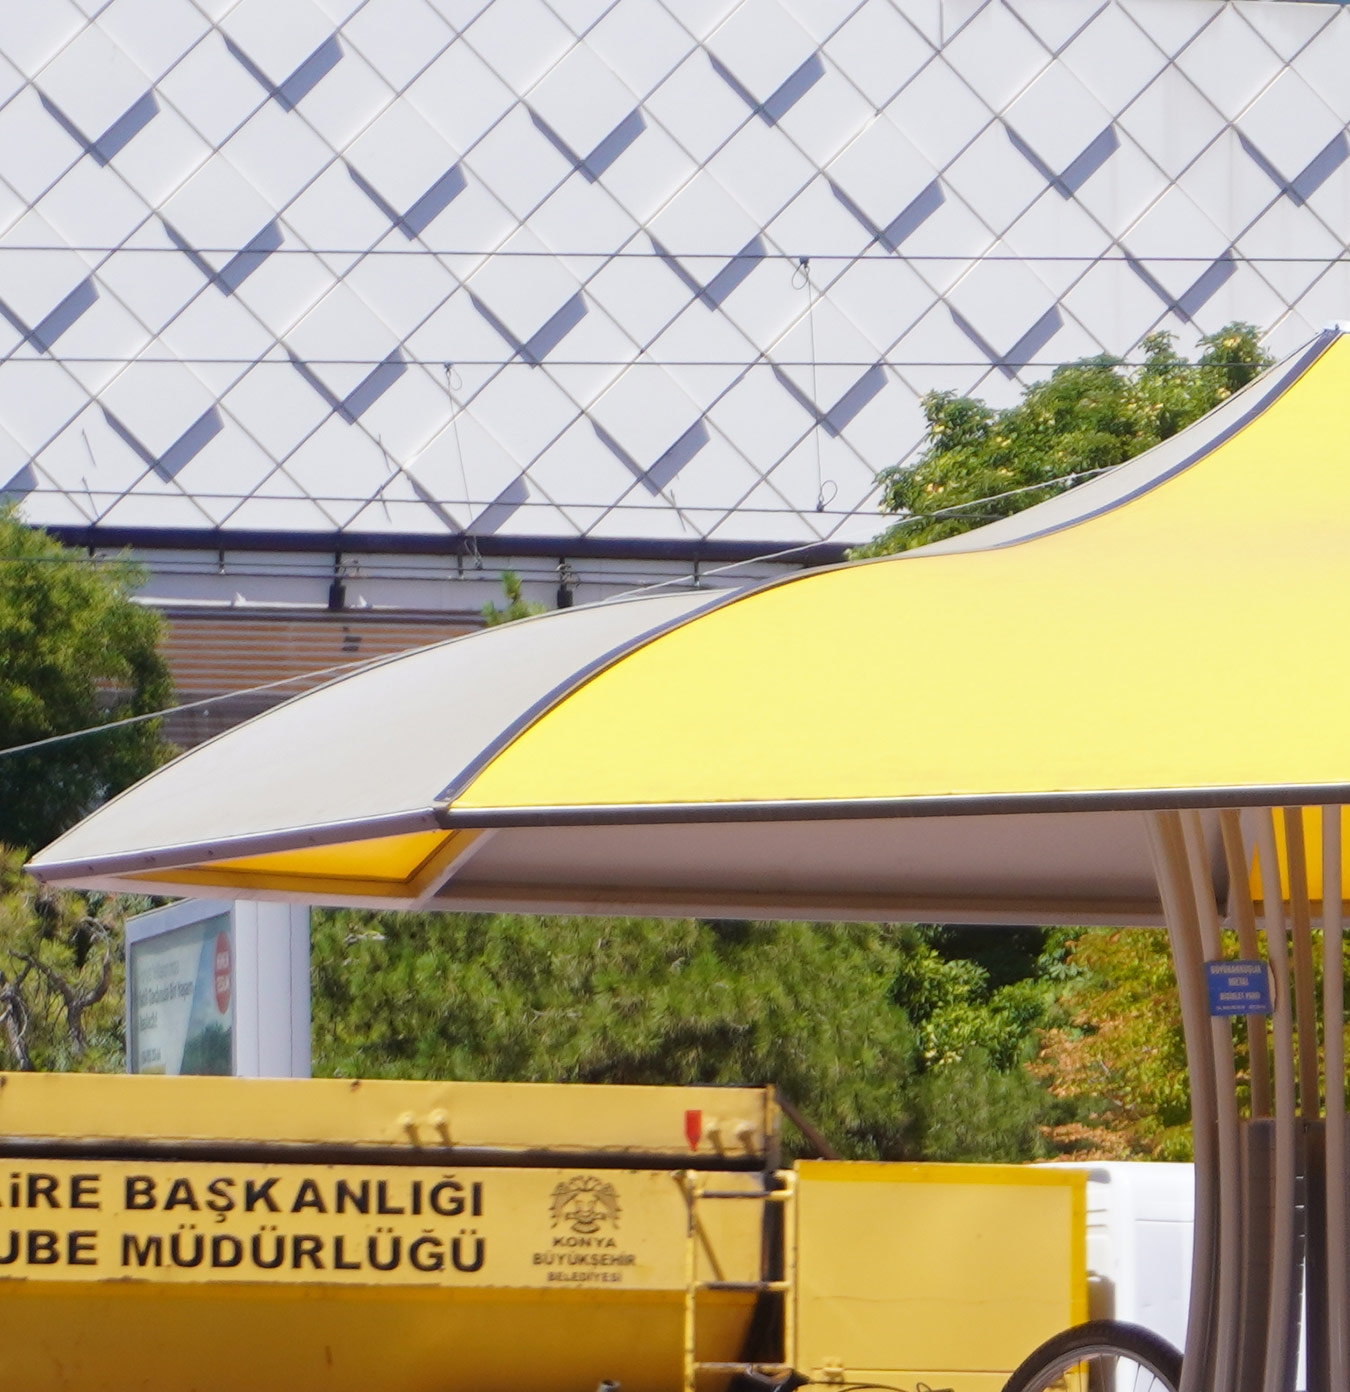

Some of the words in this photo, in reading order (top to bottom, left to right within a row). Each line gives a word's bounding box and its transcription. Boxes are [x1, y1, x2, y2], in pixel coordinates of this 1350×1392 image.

[124, 1174, 484, 1223] BAŞKANLIĞI
[121, 1223, 486, 1272] MÜDÜRLÜĞÜ
[552, 1236, 617, 1248] KONYA
[532, 1250, 637, 1269] BÜYÜKŞEHİR
